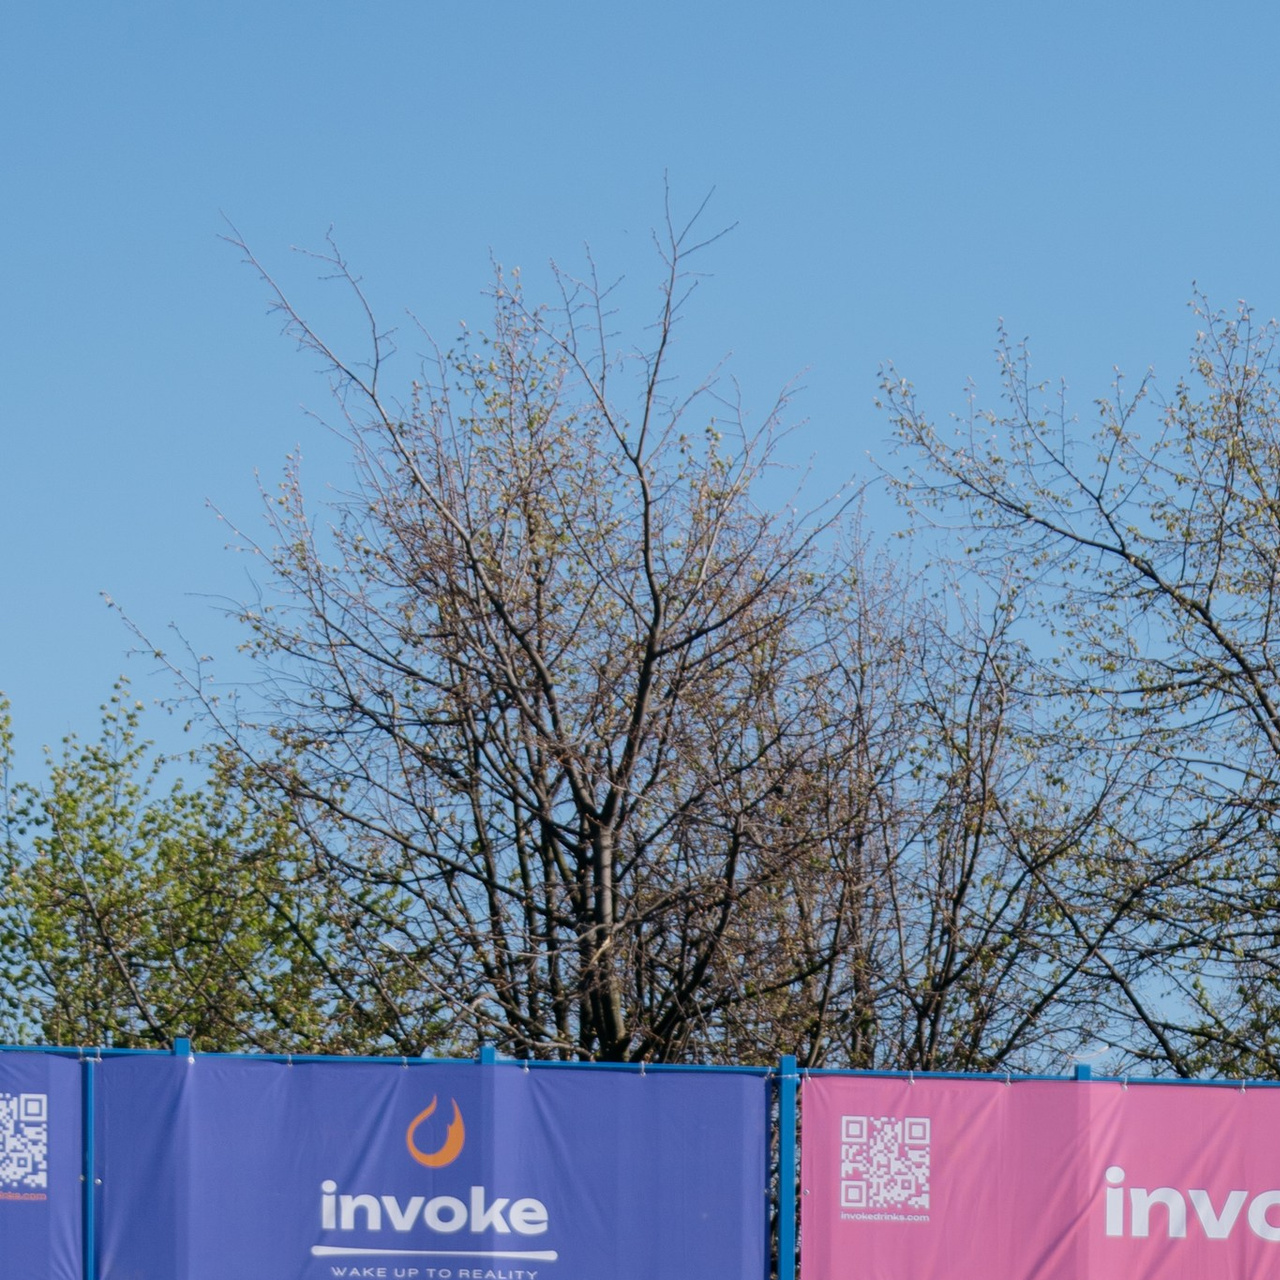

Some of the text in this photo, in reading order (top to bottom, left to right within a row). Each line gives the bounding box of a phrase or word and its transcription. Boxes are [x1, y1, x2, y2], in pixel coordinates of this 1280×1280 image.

[321, 1179, 548, 1235] invoke
[840, 1211, 930, 1222] invokedrinks.com
[331, 1266, 538, 1280] WAKE UP TO REALITY
